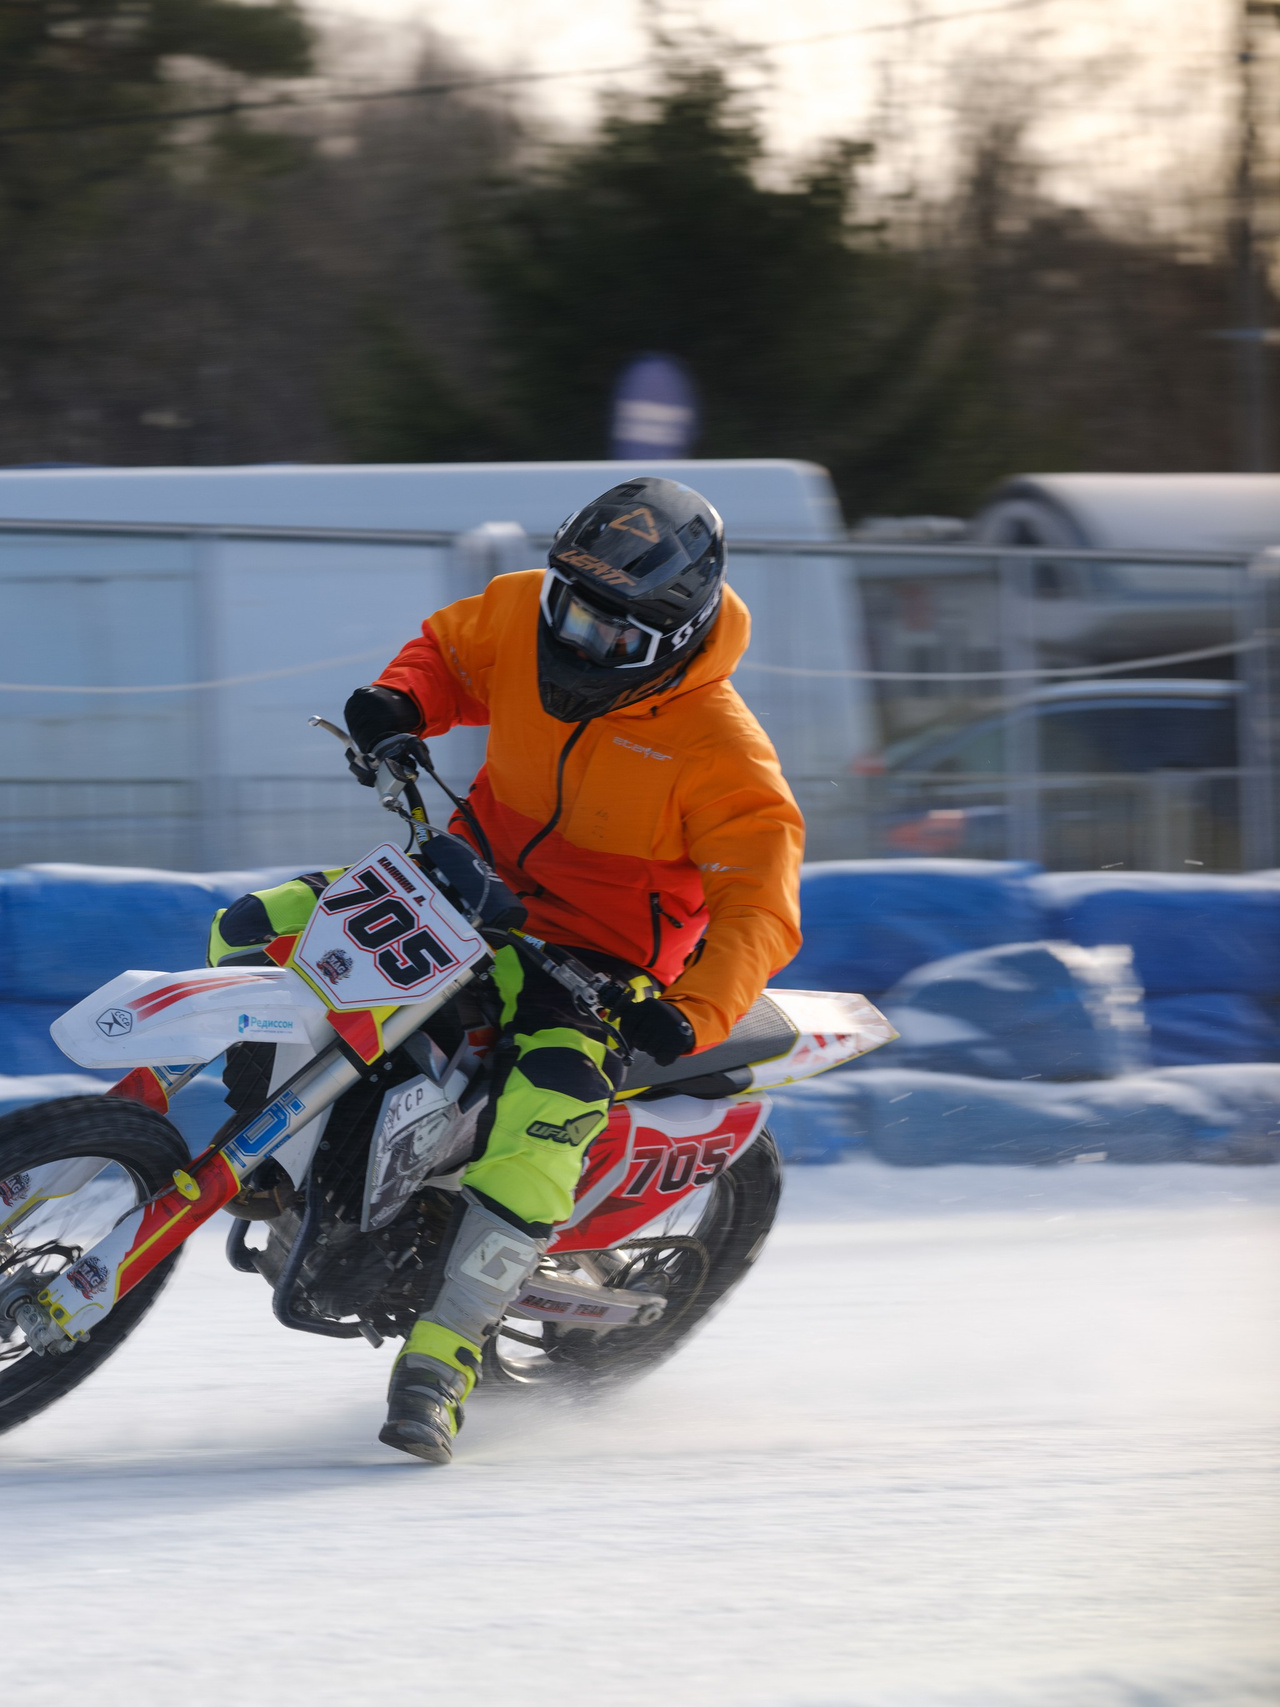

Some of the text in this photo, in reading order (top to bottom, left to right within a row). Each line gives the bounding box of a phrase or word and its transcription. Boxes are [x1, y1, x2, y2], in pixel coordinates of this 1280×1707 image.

[556, 550, 637, 587] LEATT
[377, 856, 417, 895] КАЛИНИН
[321, 866, 458, 988] 705
[250, 1016, 294, 1030] Редиссон
[622, 1133, 735, 1198] 705
[79, 1263, 101, 1288] MAG
[572, 1303, 611, 1318] TEAM
